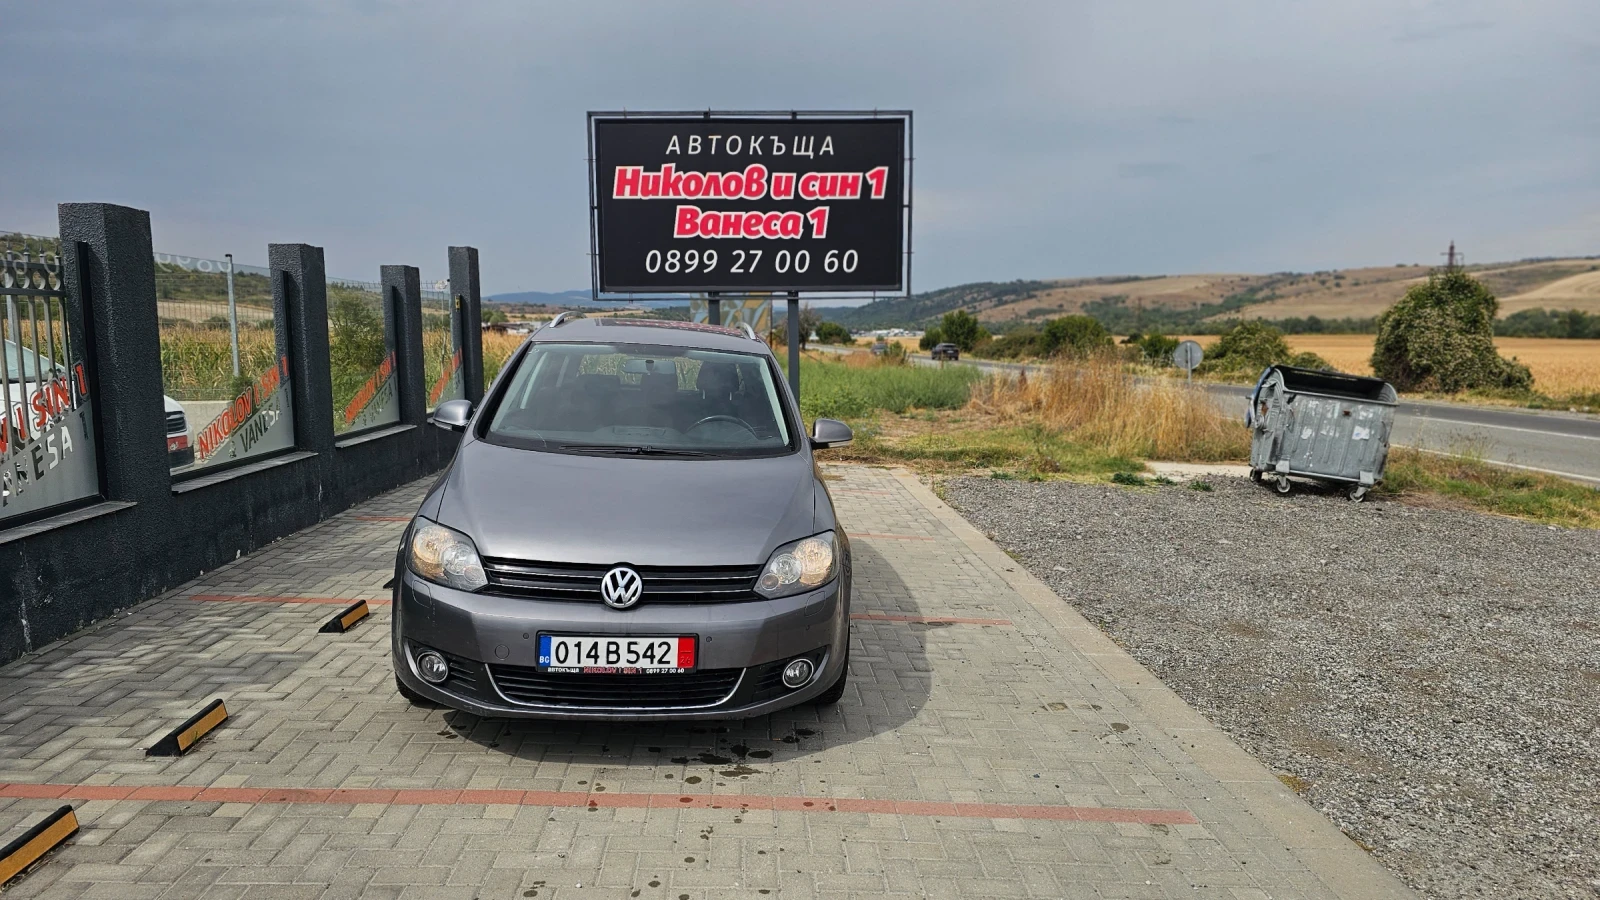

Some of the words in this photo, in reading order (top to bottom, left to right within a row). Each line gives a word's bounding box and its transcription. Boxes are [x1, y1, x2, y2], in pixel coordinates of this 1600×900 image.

[665, 135, 835, 159] АВТОКЪЩА
[612, 163, 768, 200] Николов
[770, 172, 797, 200] и
[798, 171, 864, 200] син
[865, 166, 889, 199] 1
[673, 204, 804, 239] Ванеса
[806, 206, 830, 239] 1
[645, 250, 718, 273] 0899
[730, 250, 763, 273] 27
[775, 250, 811, 273] 00
[823, 250, 859, 273] 60
[30, 375, 71, 432] SIN
[73, 360, 88, 400] 1
[197, 386, 253, 461] NIKOLOV
[1, 425, 74, 508] ANESA
[539, 656, 550, 664] BG
[555, 641, 672, 665] 014B542
